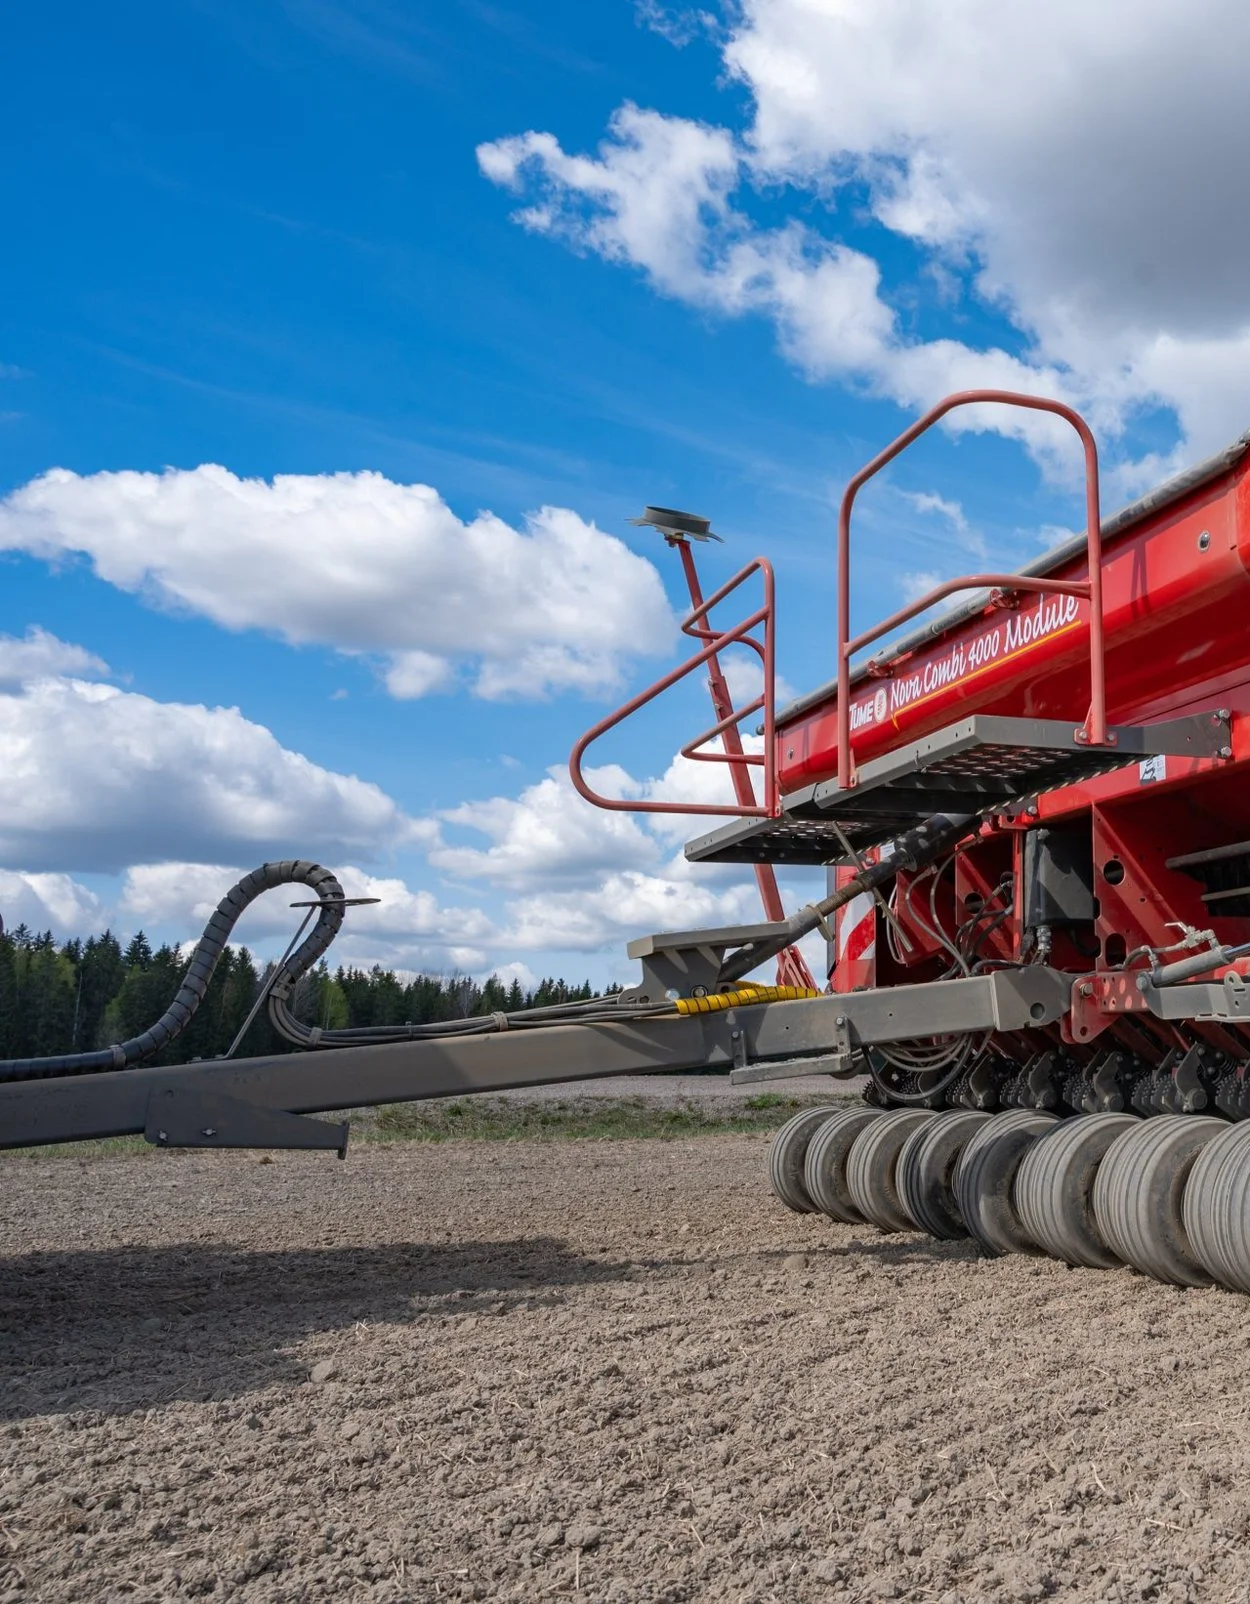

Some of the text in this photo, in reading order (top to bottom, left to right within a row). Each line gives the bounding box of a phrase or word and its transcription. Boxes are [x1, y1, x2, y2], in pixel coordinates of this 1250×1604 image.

[849, 592, 1079, 731] TUME Nova Combi 4000 Module
